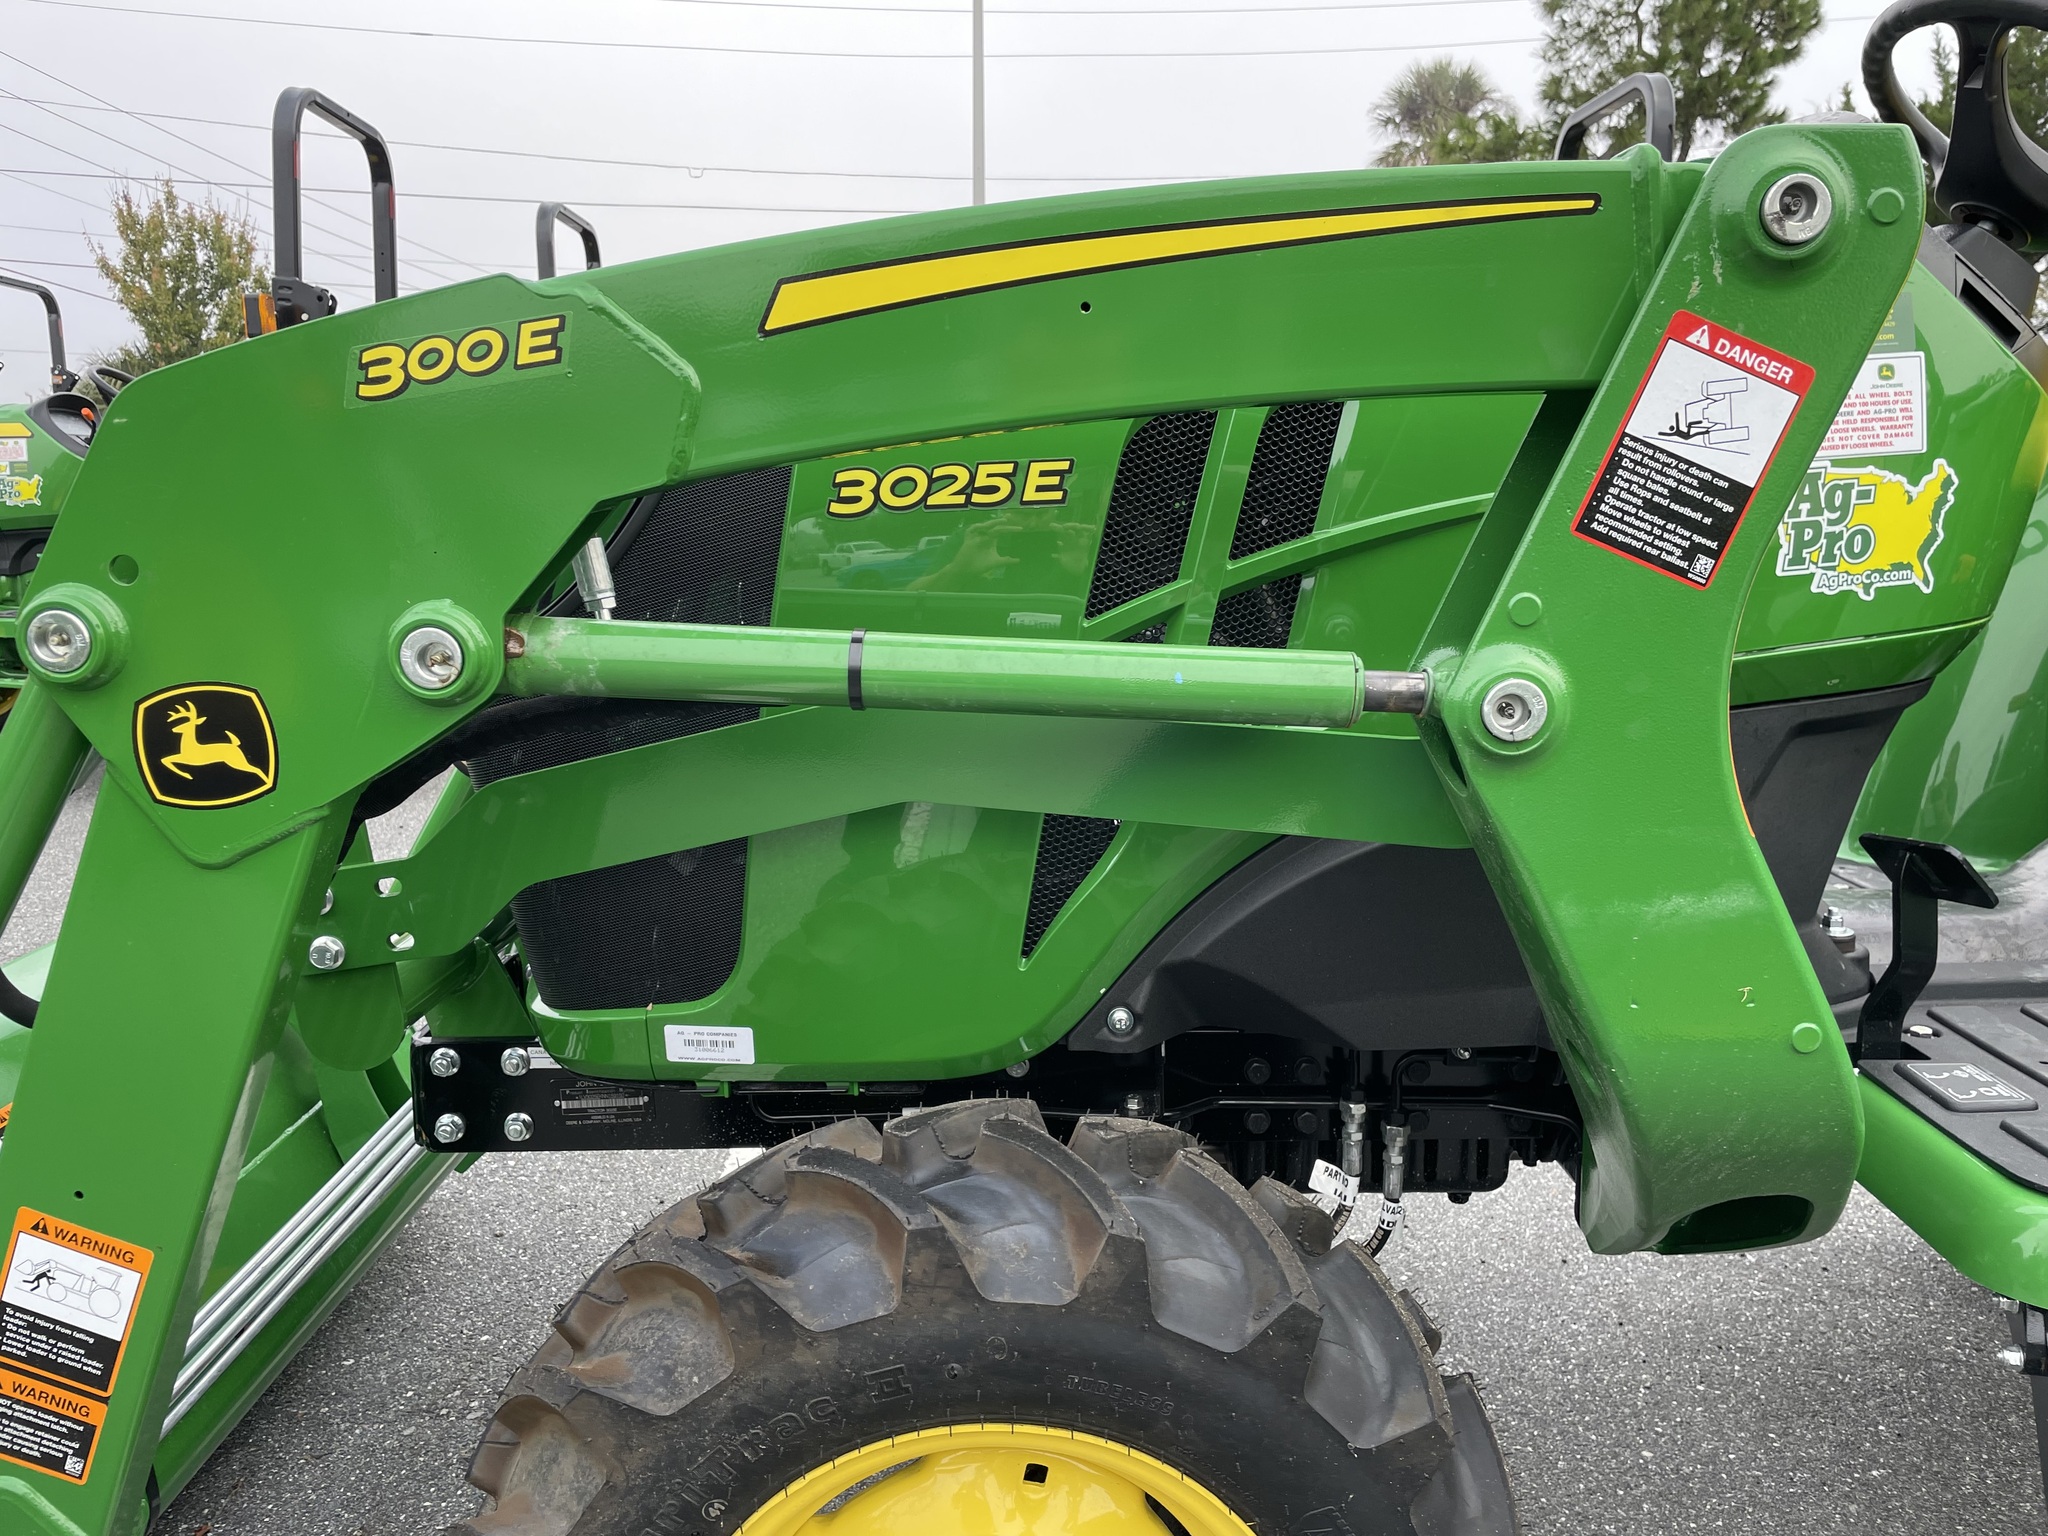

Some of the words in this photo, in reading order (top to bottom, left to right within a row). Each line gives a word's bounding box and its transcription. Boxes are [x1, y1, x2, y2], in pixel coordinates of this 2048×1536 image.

[1713, 338, 1794, 385] DANGER
[1617, 468, 1646, 486] square
[1646, 480, 1670, 496] bales.
[1618, 447, 1642, 462] result
[1642, 456, 1662, 471] from
[1662, 465, 1699, 488] rollovers.
[1622, 437, 1654, 456] Serious
[1654, 450, 1678, 469] injury
[1678, 462, 1688, 471] or
[1688, 465, 1713, 482] death
[1713, 477, 1729, 489] can
[1608, 486, 1617, 496] all
[1618, 490, 1644, 507] times.
[1613, 477, 1629, 489] Use
[1630, 484, 1652, 500] Rops
[1652, 494, 1668, 506] and
[1669, 501, 1702, 521] seatbelt
[1703, 516, 1712, 525] at
[1621, 458, 1634, 469] Do
[1634, 465, 1649, 475] not
[1650, 470, 1678, 487] handle
[1678, 483, 1702, 499] round
[1703, 495, 1713, 503] or
[1713, 498, 1734, 513] large
[1786, 469, 1874, 527] Ag-
[1594, 513, 1654, 543] recommended
[1653, 538, 1683, 556] setting.
[1599, 504, 1623, 519] Move
[1623, 513, 1652, 531] wheels
[1653, 526, 1662, 535] to
[1662, 530, 1691, 548] widest
[1604, 495, 1637, 514] Operate
[1637, 508, 1666, 527] tractor
[1666, 520, 1676, 530] at
[1676, 524, 1691, 539] low
[1691, 532, 1718, 550] speed.
[1590, 522, 1608, 534] Add
[1608, 529, 1643, 549] required
[1643, 543, 1661, 556] rear
[1660, 550, 1690, 570] ballast.
[1785, 519, 1874, 569] Pro
[1817, 569, 1913, 589] AgProCo.com
[54, 1226, 136, 1264] WARNING
[15, 1311, 34, 1322] avoid
[35, 1318, 55, 1329] injury
[55, 1325, 72, 1335] from
[72, 1331, 94, 1344] falling
[31, 1332, 47, 1342] walk
[57, 1341, 85, 1354] perform
[1, 1345, 28, 1357] parked.
[3, 1337, 25, 1348] Lower
[25, 1344, 48, 1356] loader
[57, 1356, 81, 1369] ground
[82, 1365, 101, 1375] when
[5, 1331, 31, 1343] service
[31, 1340, 52, 1350] under
[58, 1349, 80, 1360] raised
[81, 1356, 104, 1369] loader.
[0, 1398, 12, 1406] OT
[12, 1403, 37, 1415] operate
[38, 1411, 59, 1422] loader
[59, 1420, 84, 1431] without
[12, 1381, 91, 1418] WARNING
[4, 1427, 41, 1443] attachment
[41, 1439, 73, 1455] detaching
[10, 1422, 34, 1433] engage
[35, 1430, 60, 1442] retainer
[60, 1439, 80, 1449] could
[13, 1411, 50, 1427] attachment
[50, 1423, 68, 1434] latch.
[39, 1446, 63, 1458] serious
